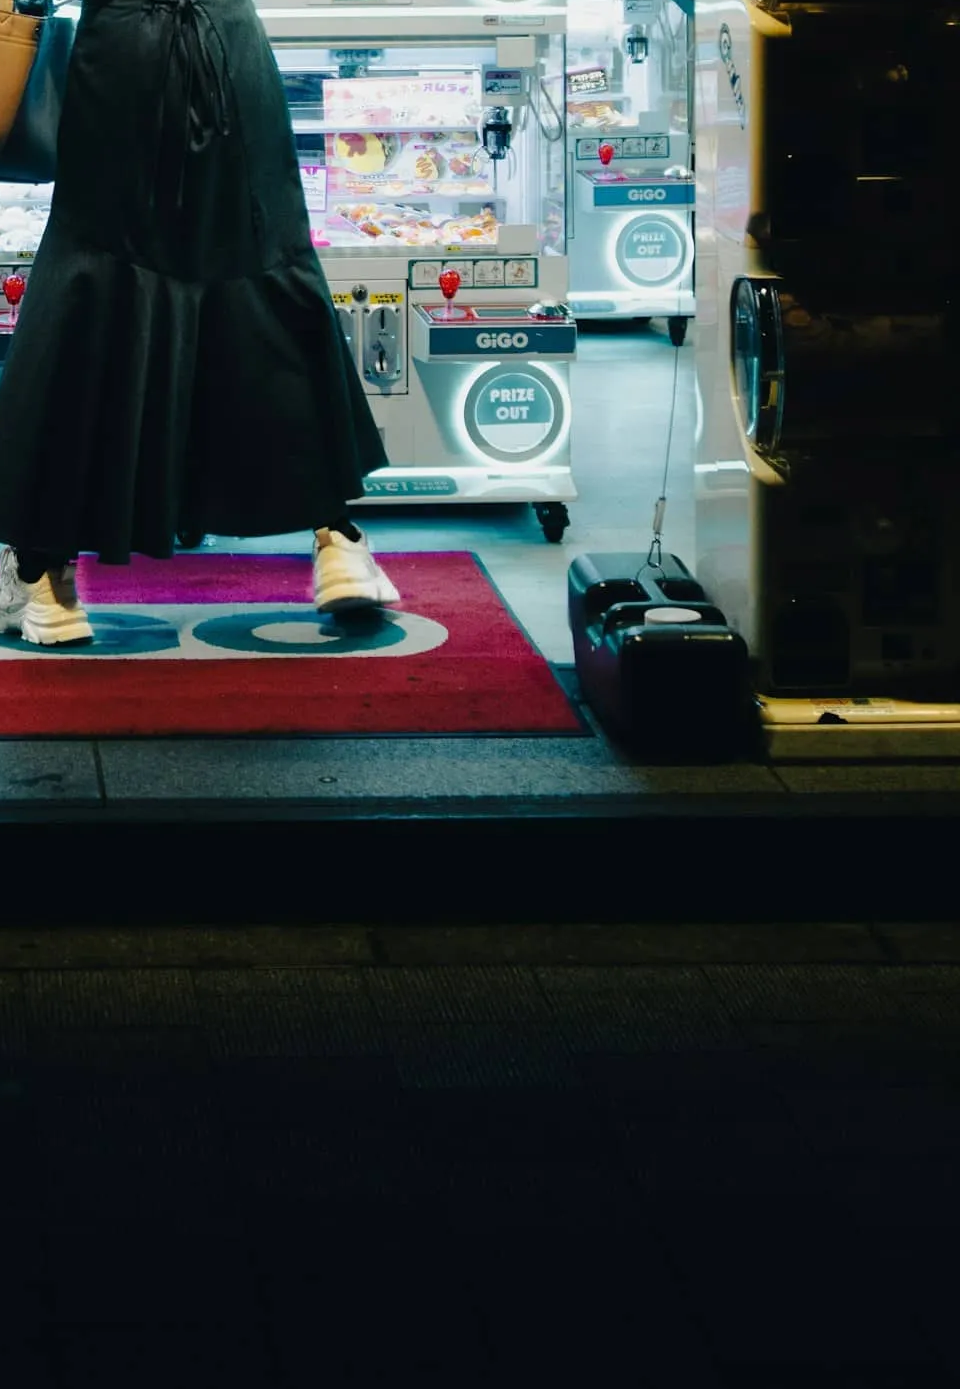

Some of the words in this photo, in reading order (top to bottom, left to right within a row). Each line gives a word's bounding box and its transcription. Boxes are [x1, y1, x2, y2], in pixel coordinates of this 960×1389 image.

[627, 188, 666, 201] GiGO
[476, 332, 529, 348] GiGO
[490, 387, 535, 403] PRIZE
[495, 406, 529, 420] OUT
